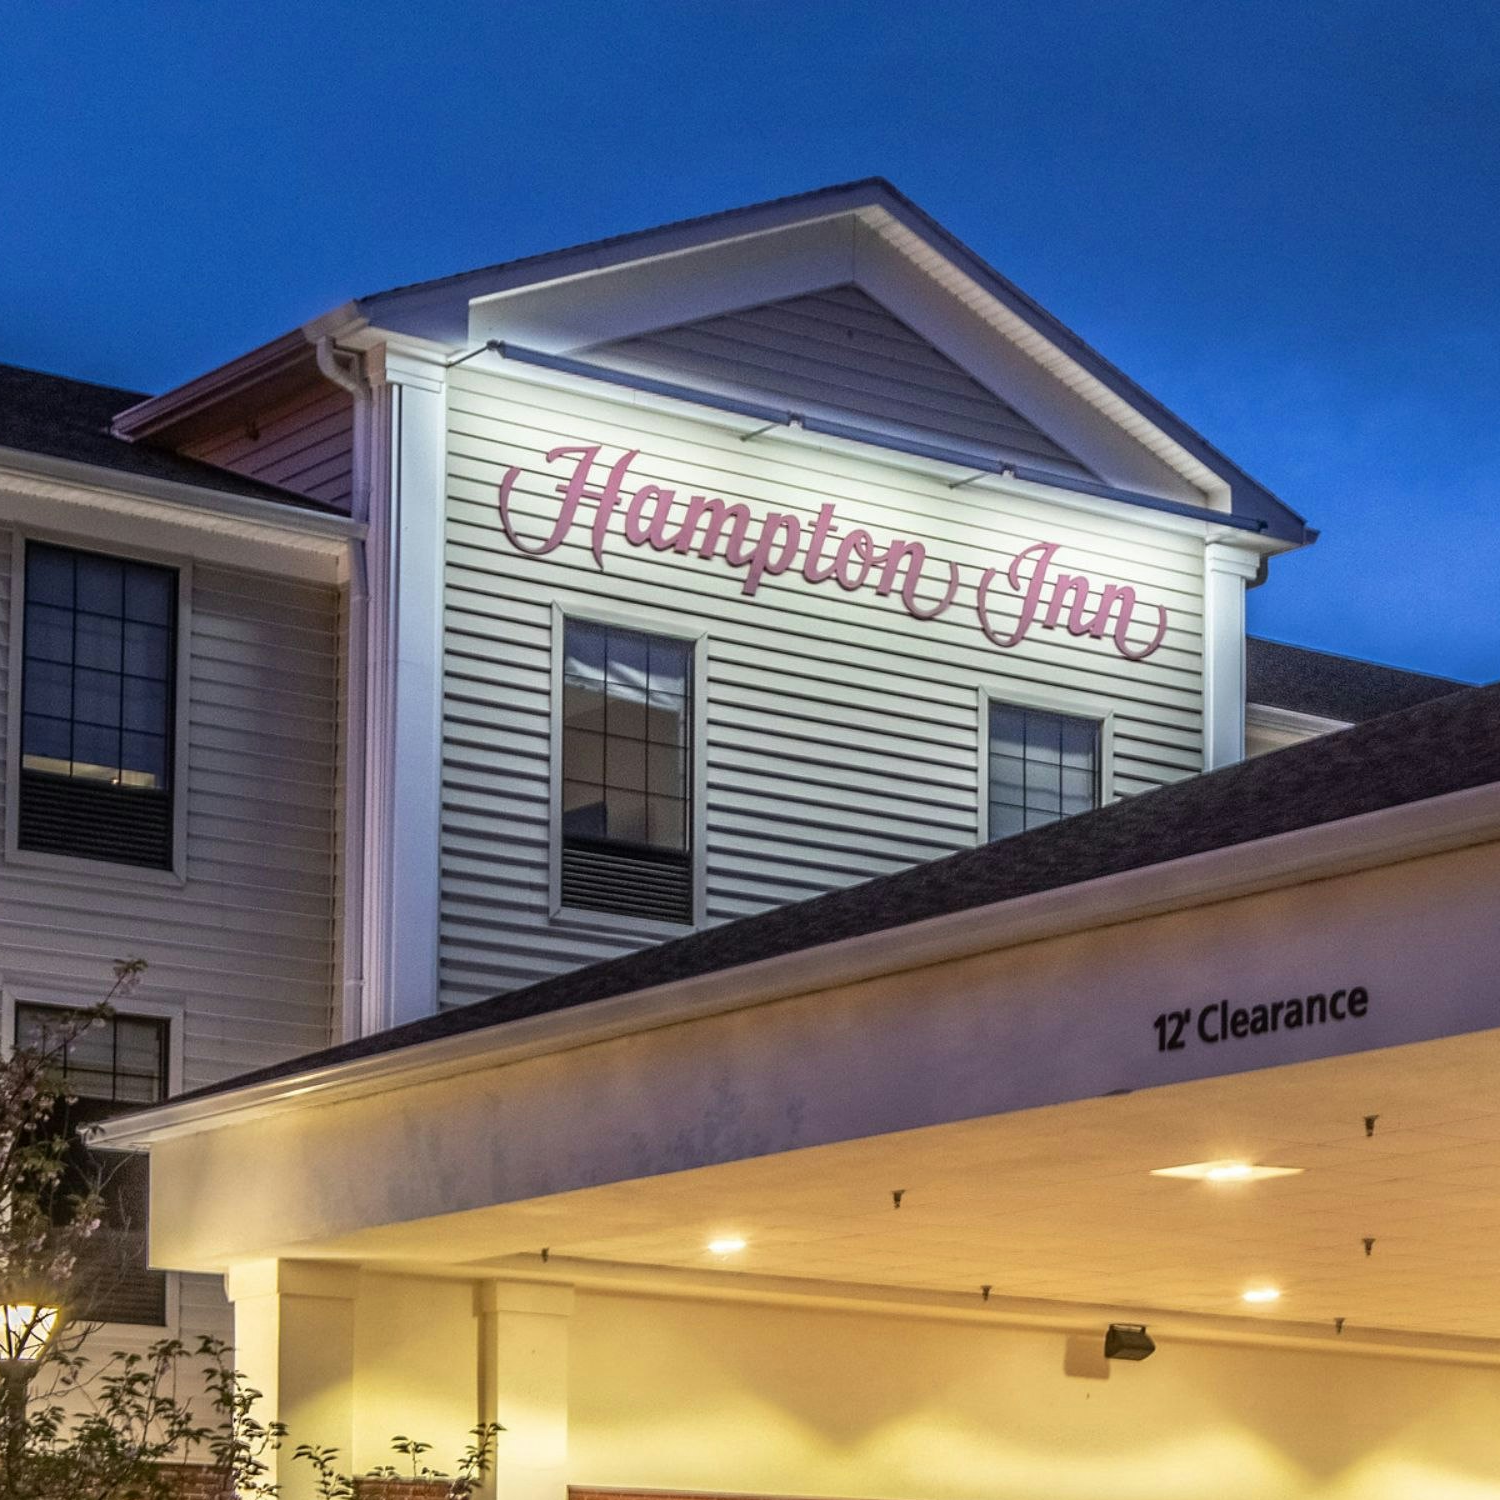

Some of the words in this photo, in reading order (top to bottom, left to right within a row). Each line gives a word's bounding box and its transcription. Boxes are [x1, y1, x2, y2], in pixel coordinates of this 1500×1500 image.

[499, 445, 958, 619] Hampton
[978, 541, 1167, 660] Inn
[1153, 1008, 1191, 1052] 12'
[1197, 986, 1369, 1043] Clearance
